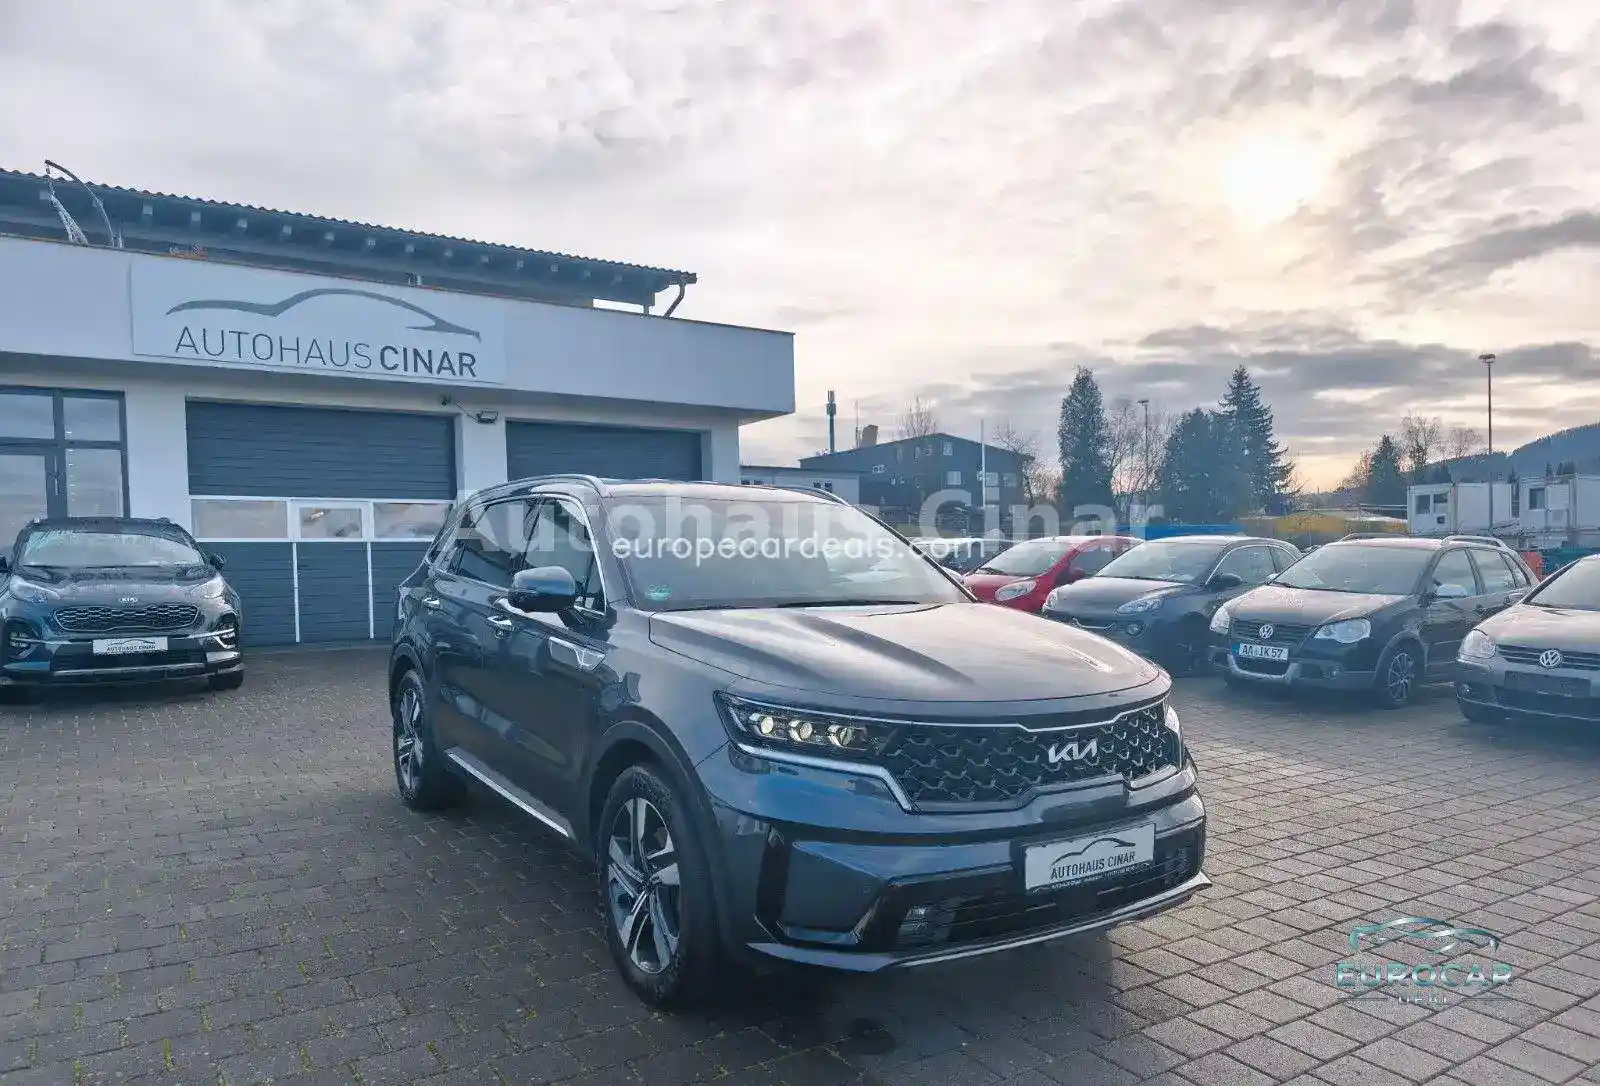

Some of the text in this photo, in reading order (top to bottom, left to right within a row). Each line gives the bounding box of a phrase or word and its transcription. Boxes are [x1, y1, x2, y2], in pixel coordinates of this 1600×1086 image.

[175, 325, 478, 378] AUTOHAUS CINAR
[1242, 645, 1253, 656] AA
[1050, 858, 1105, 880] AUTOHAUS
[1107, 851, 1136, 867] CINAR
